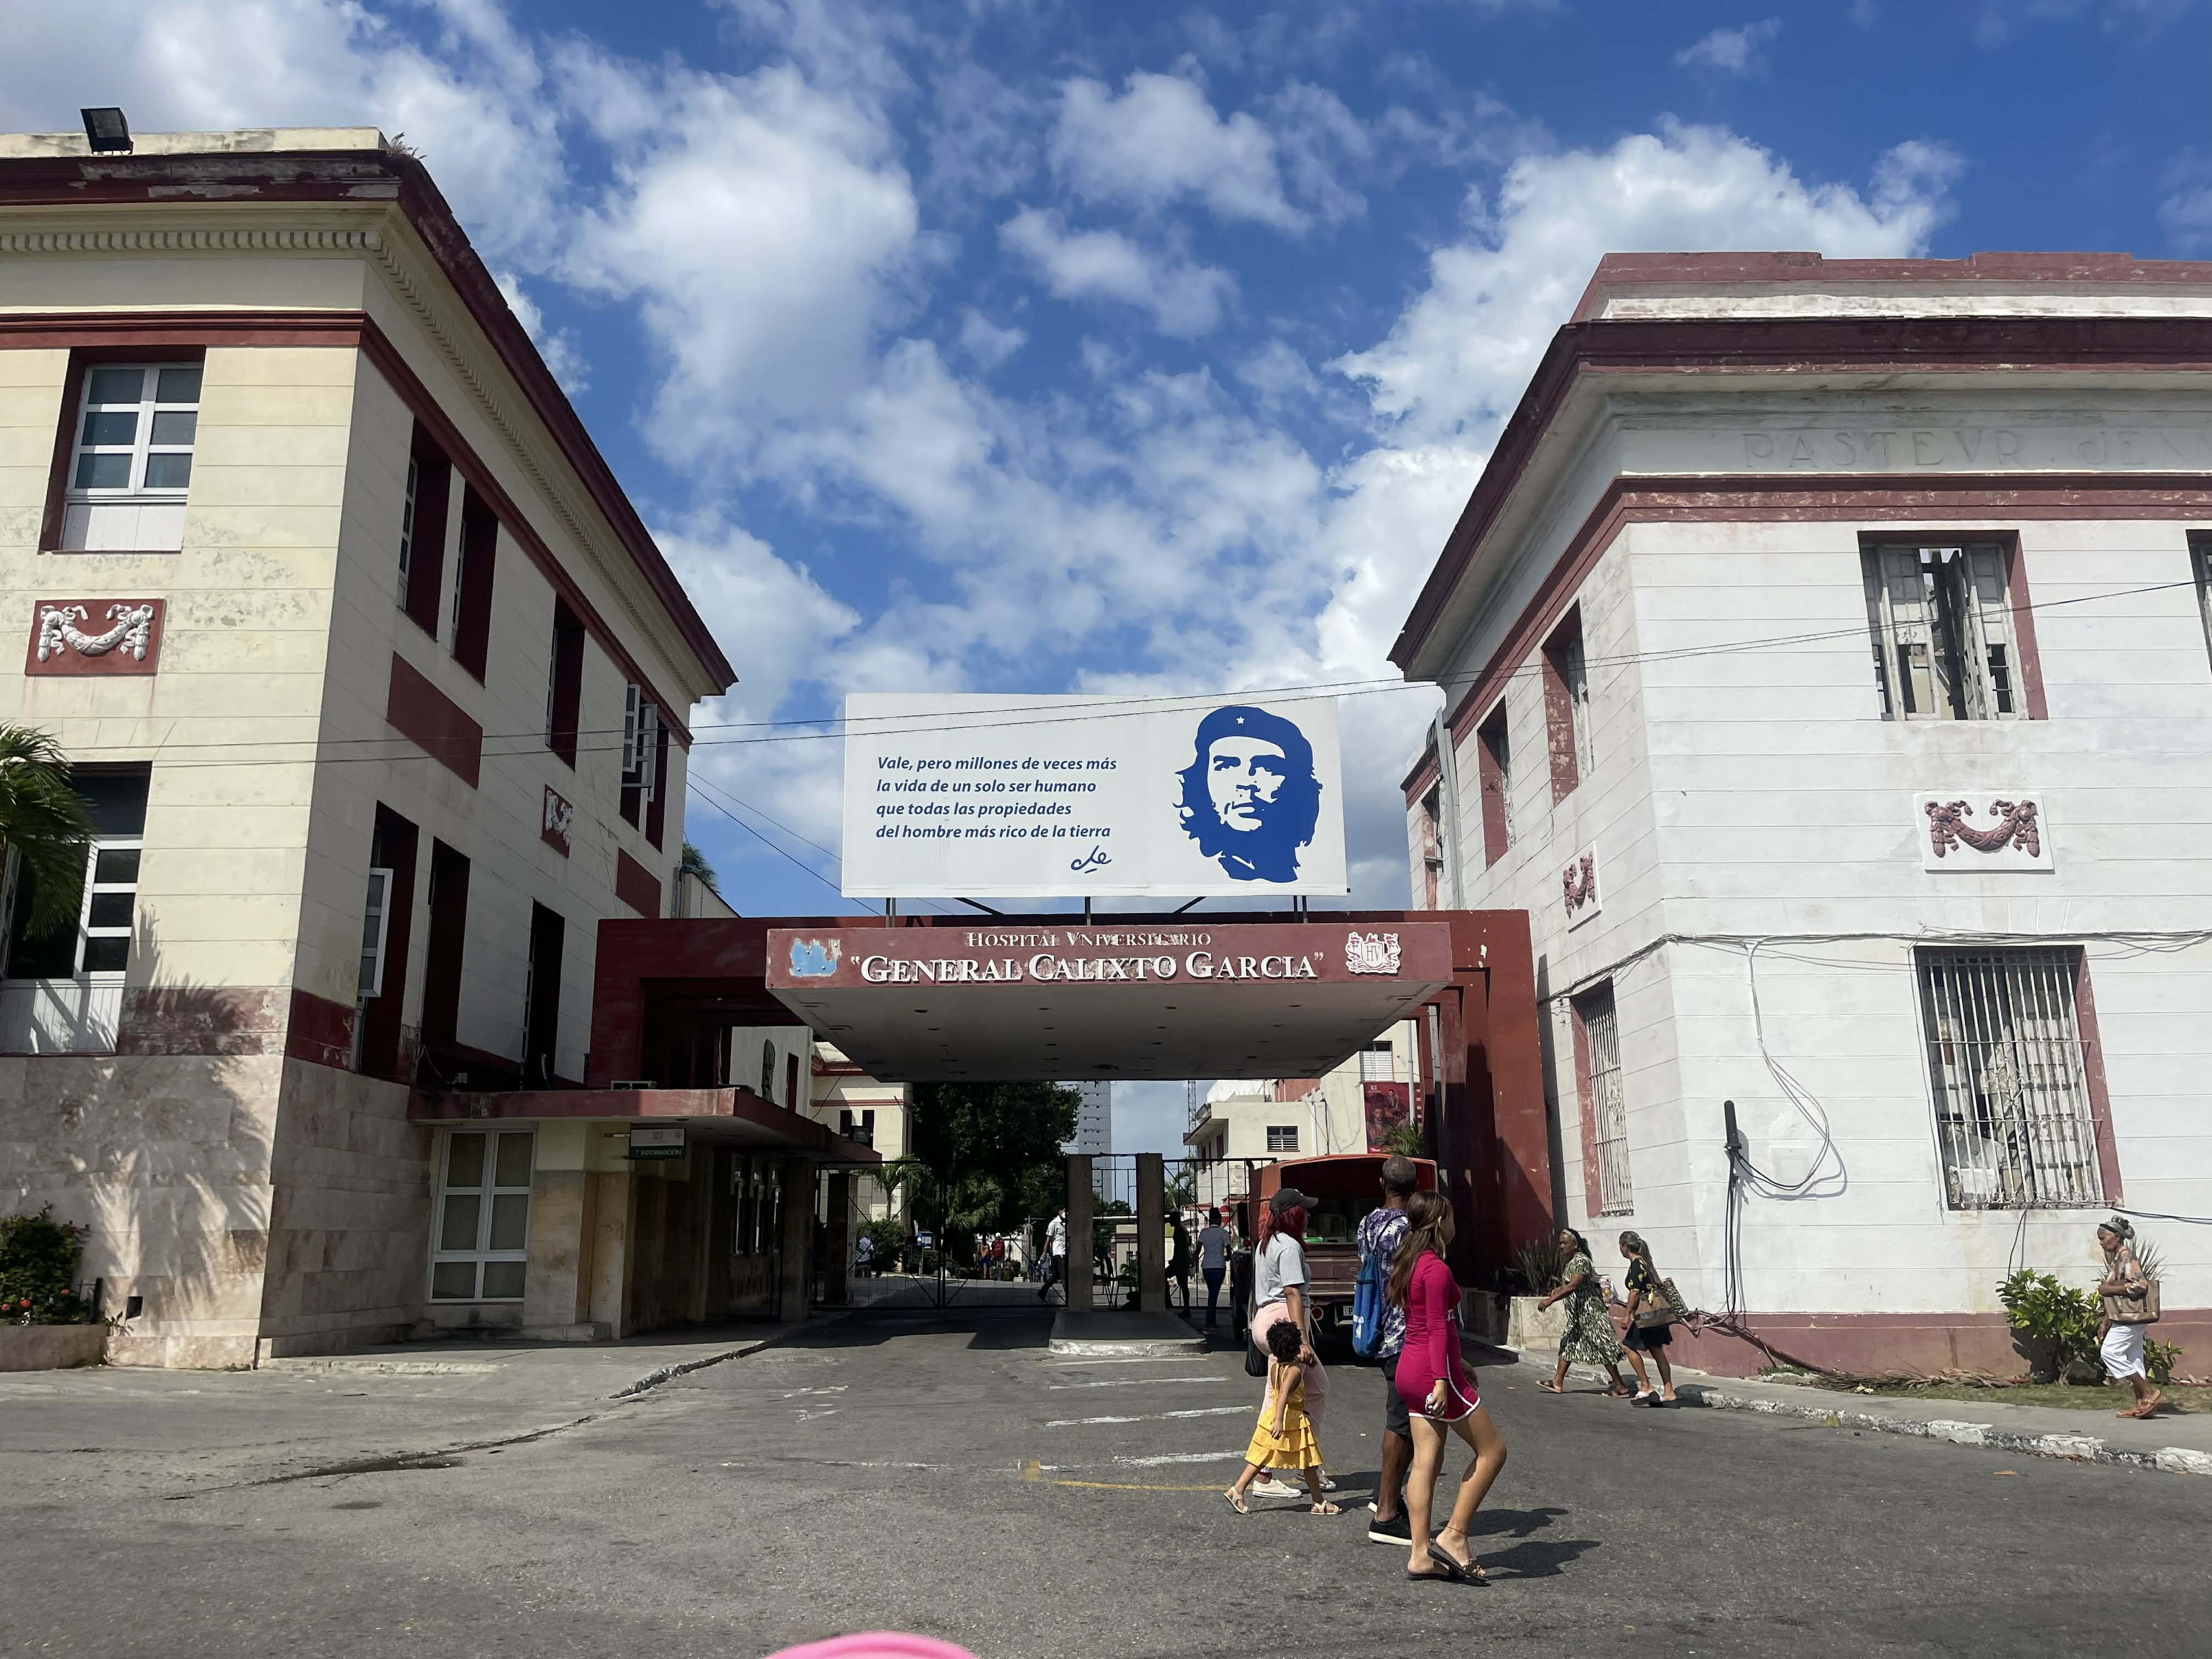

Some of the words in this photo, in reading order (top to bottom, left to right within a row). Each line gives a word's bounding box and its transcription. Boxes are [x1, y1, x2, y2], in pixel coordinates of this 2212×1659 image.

[1741, 430, 2029, 469] PASTEVR
[878, 756, 913, 771] Vale,
[916, 760, 952, 772] pero
[955, 757, 1018, 770] millones
[1022, 757, 1040, 770] de
[1043, 760, 1083, 770] veces
[1086, 757, 1116, 770] más
[877, 778, 891, 792] la
[894, 779, 927, 792] vida
[930, 779, 949, 792] de
[952, 783, 971, 792] un
[974, 779, 1006, 792] solo
[1008, 783, 1032, 792] ser
[1034, 779, 1096, 792] humano
[876, 803, 905, 817] que
[908, 802, 950, 815] todas
[953, 802, 975, 815] las
[978, 802, 1071, 818] propiedades
[876, 825, 900, 838] del
[902, 825, 962, 838] hombre
[964, 825, 996, 838] más
[999, 825, 1028, 838] rico
[1030, 825, 1049, 838] de
[1052, 825, 1066, 838] la
[1070, 825, 1111, 837] tierra
[1029, 953, 1177, 981] CALIXTO
